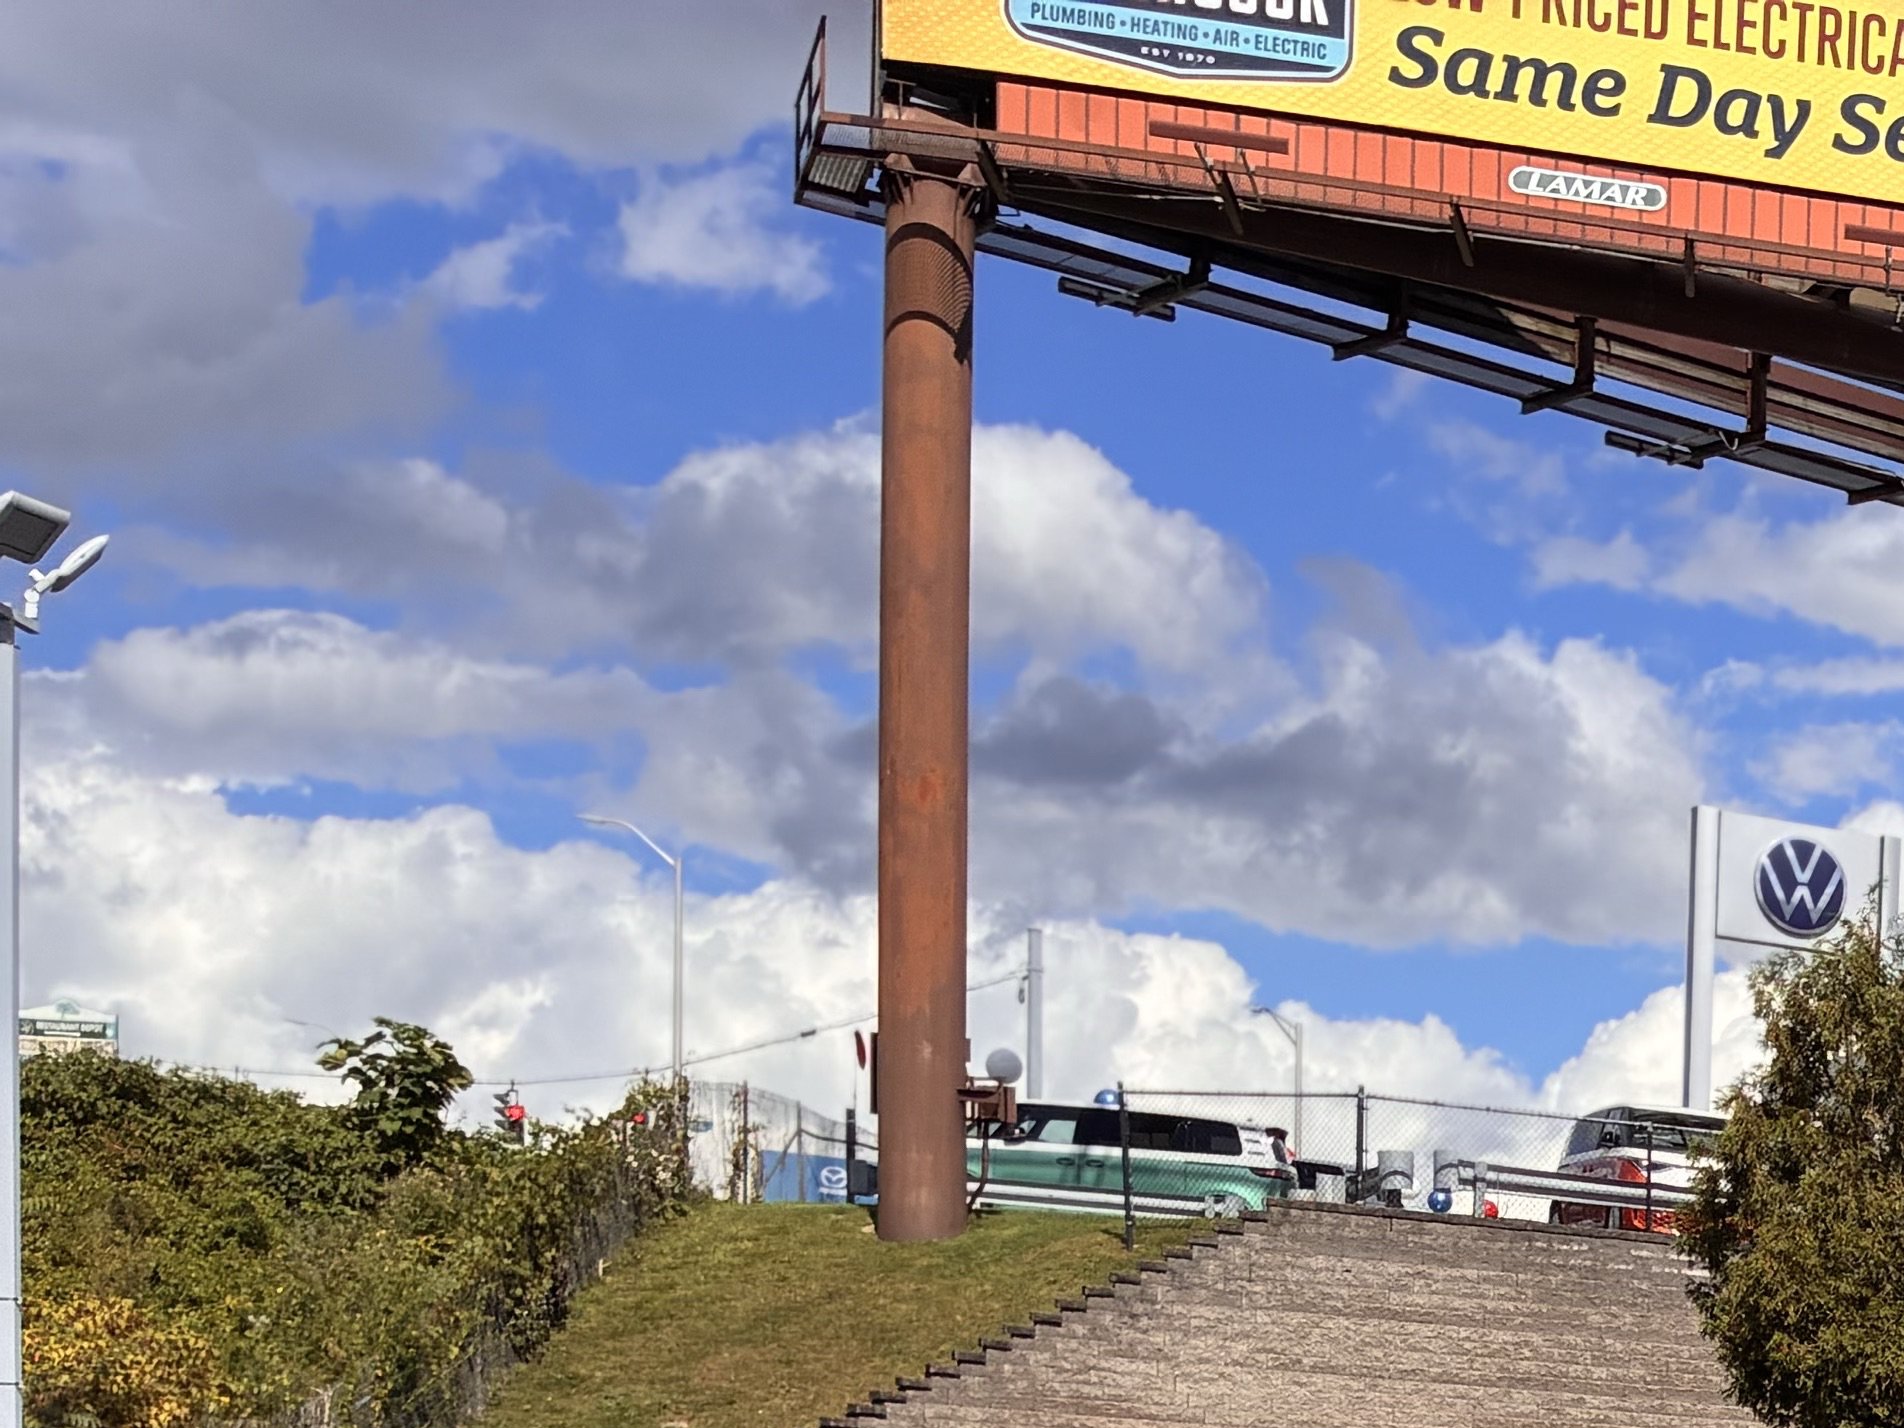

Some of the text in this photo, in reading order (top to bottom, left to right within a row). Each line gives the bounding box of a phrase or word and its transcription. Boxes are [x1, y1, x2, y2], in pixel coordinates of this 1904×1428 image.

[1030, 6, 1328, 61] PLUMBING HEATING AIR ELECTRIC
[1511, 0, 1669, 41] CED
[1388, 25, 1627, 118] Same
[1646, 63, 1812, 160] Day
[1528, 171, 1649, 207] LAMAR
